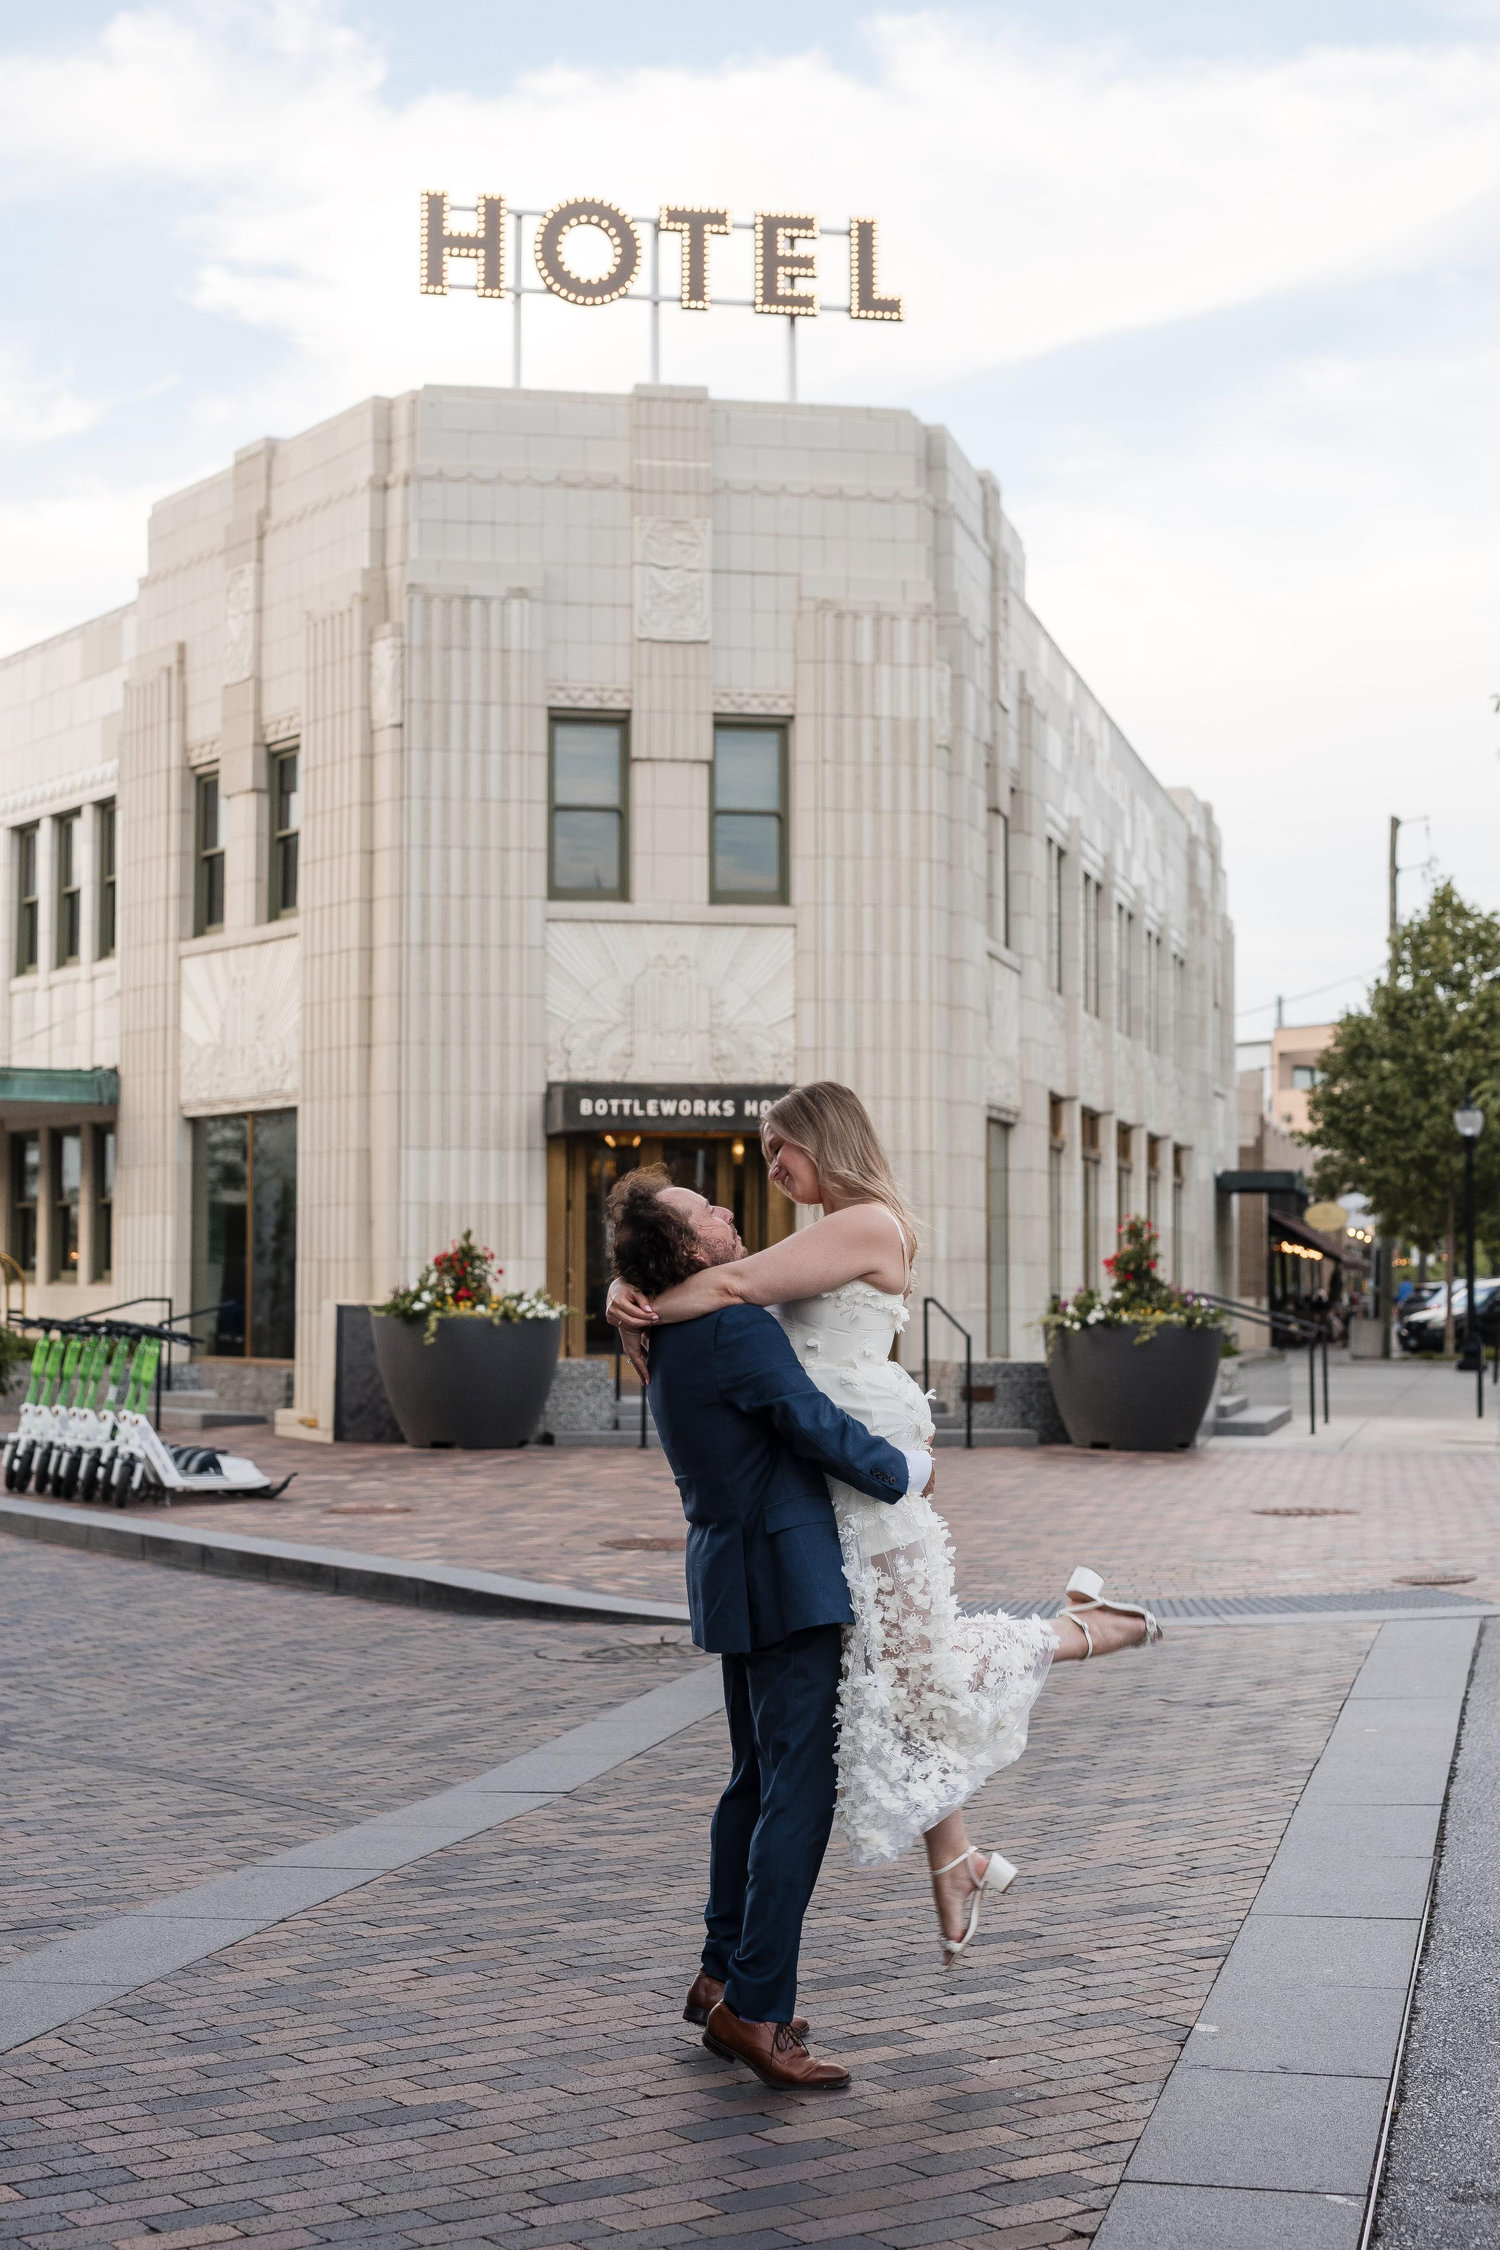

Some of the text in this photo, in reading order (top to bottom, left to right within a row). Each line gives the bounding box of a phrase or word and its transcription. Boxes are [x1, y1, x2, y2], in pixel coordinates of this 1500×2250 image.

[420, 189, 905, 321] HOTEL
[579, 1098, 776, 1117] BOTTLEWORKS HO
